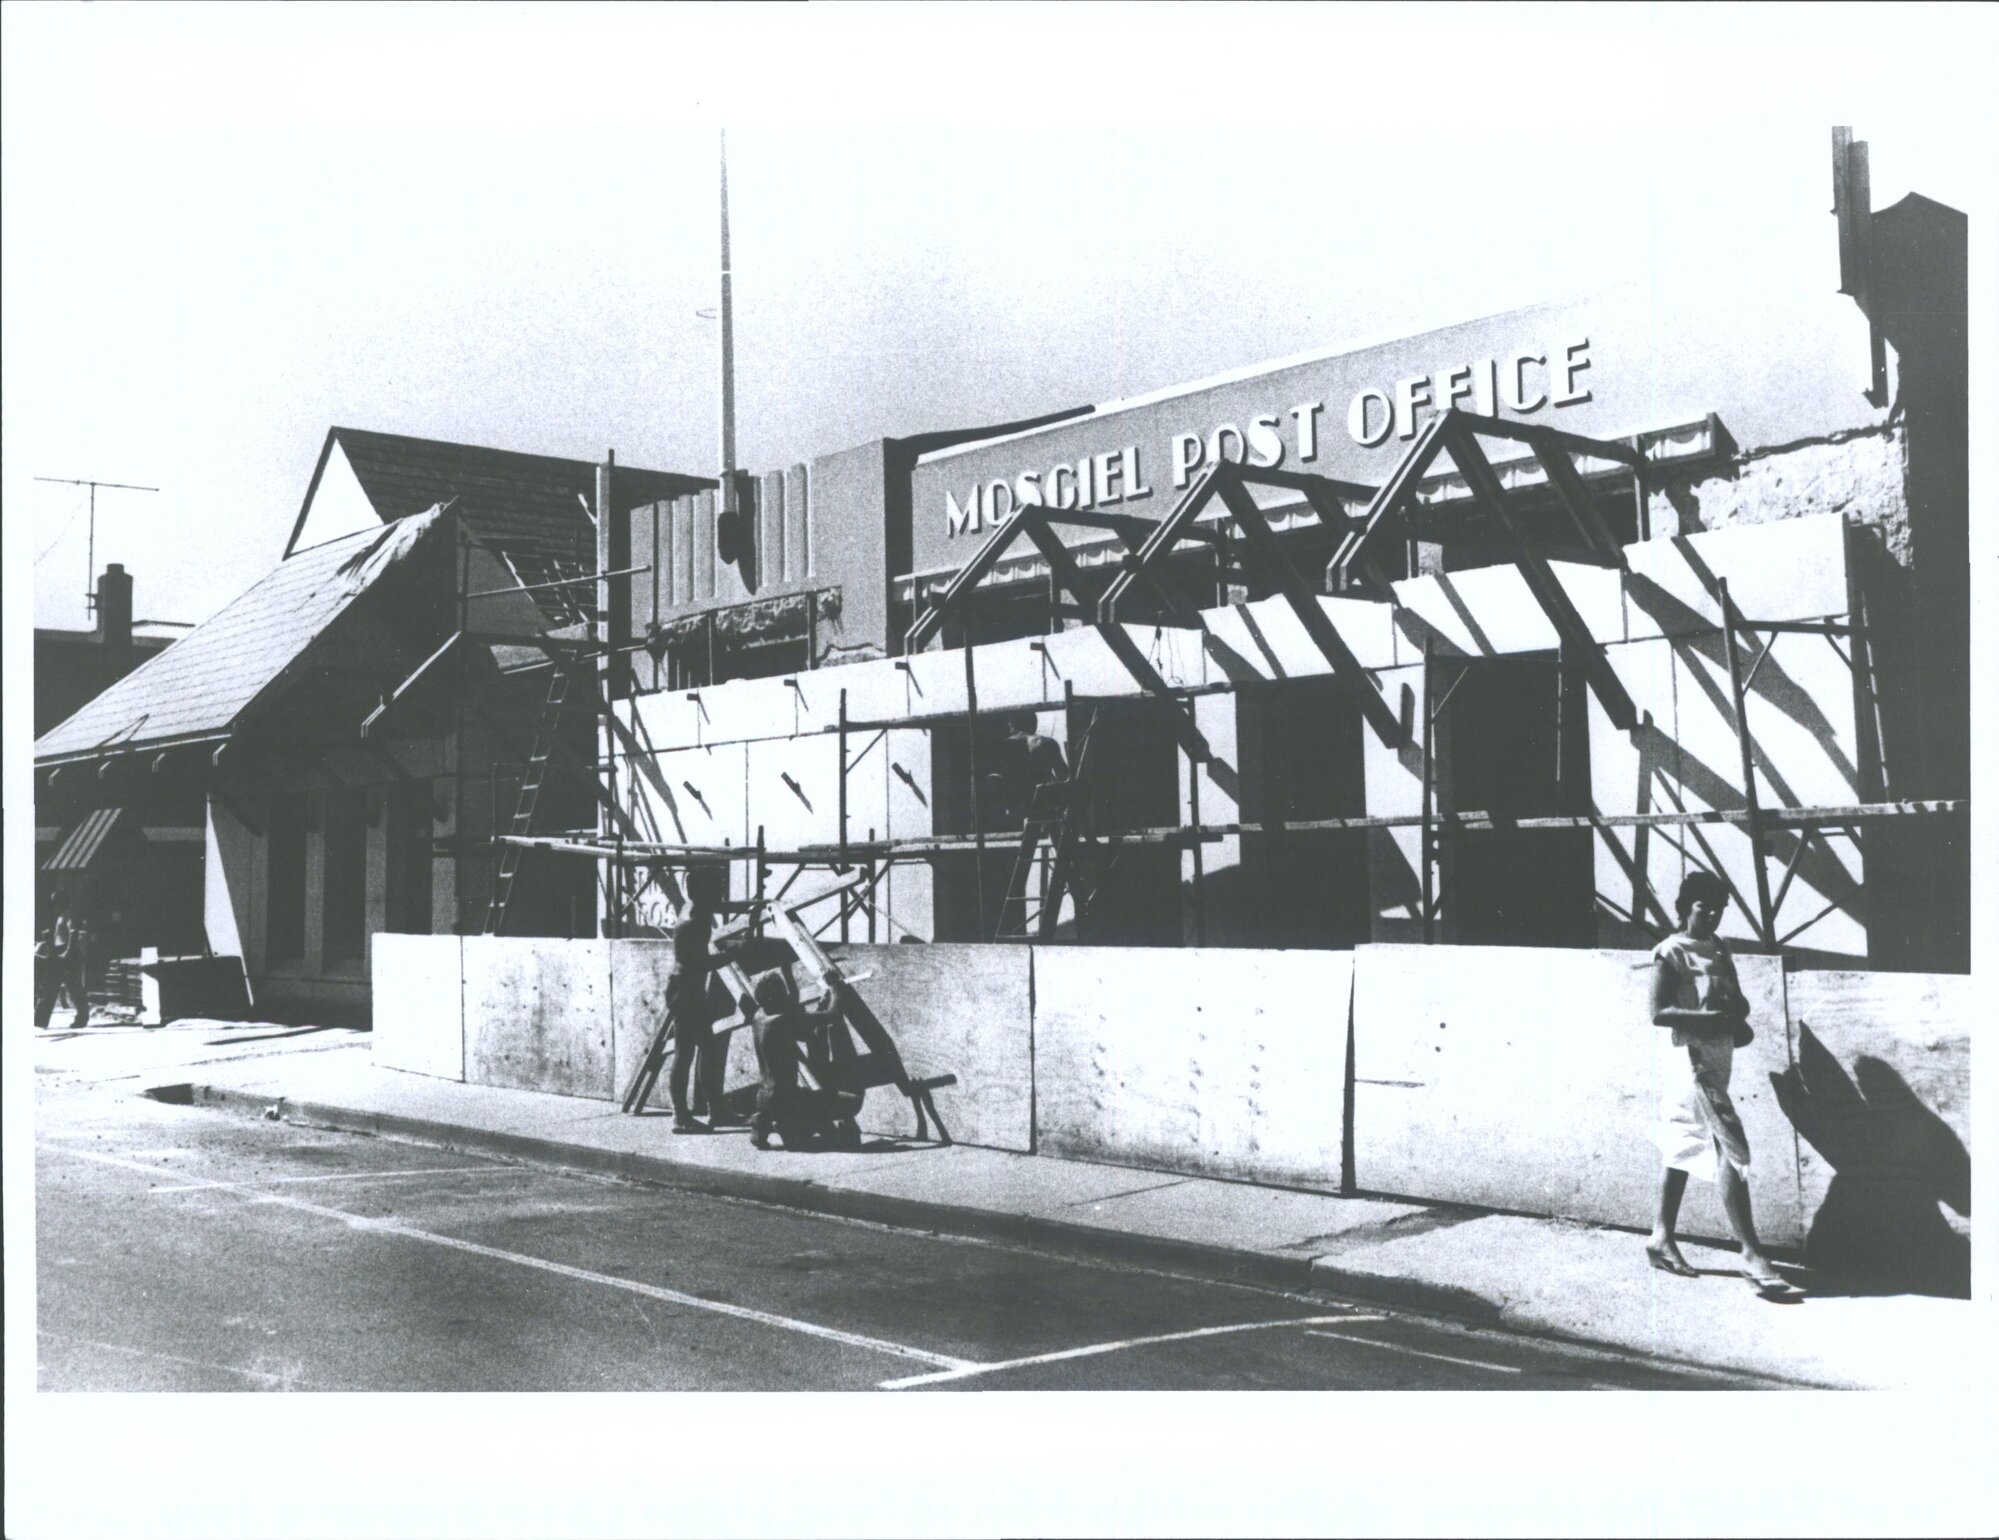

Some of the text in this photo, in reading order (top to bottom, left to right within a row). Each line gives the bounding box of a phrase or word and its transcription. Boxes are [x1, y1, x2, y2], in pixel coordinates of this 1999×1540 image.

[946, 336, 1592, 538] MOSGIEL POST OFFICE
